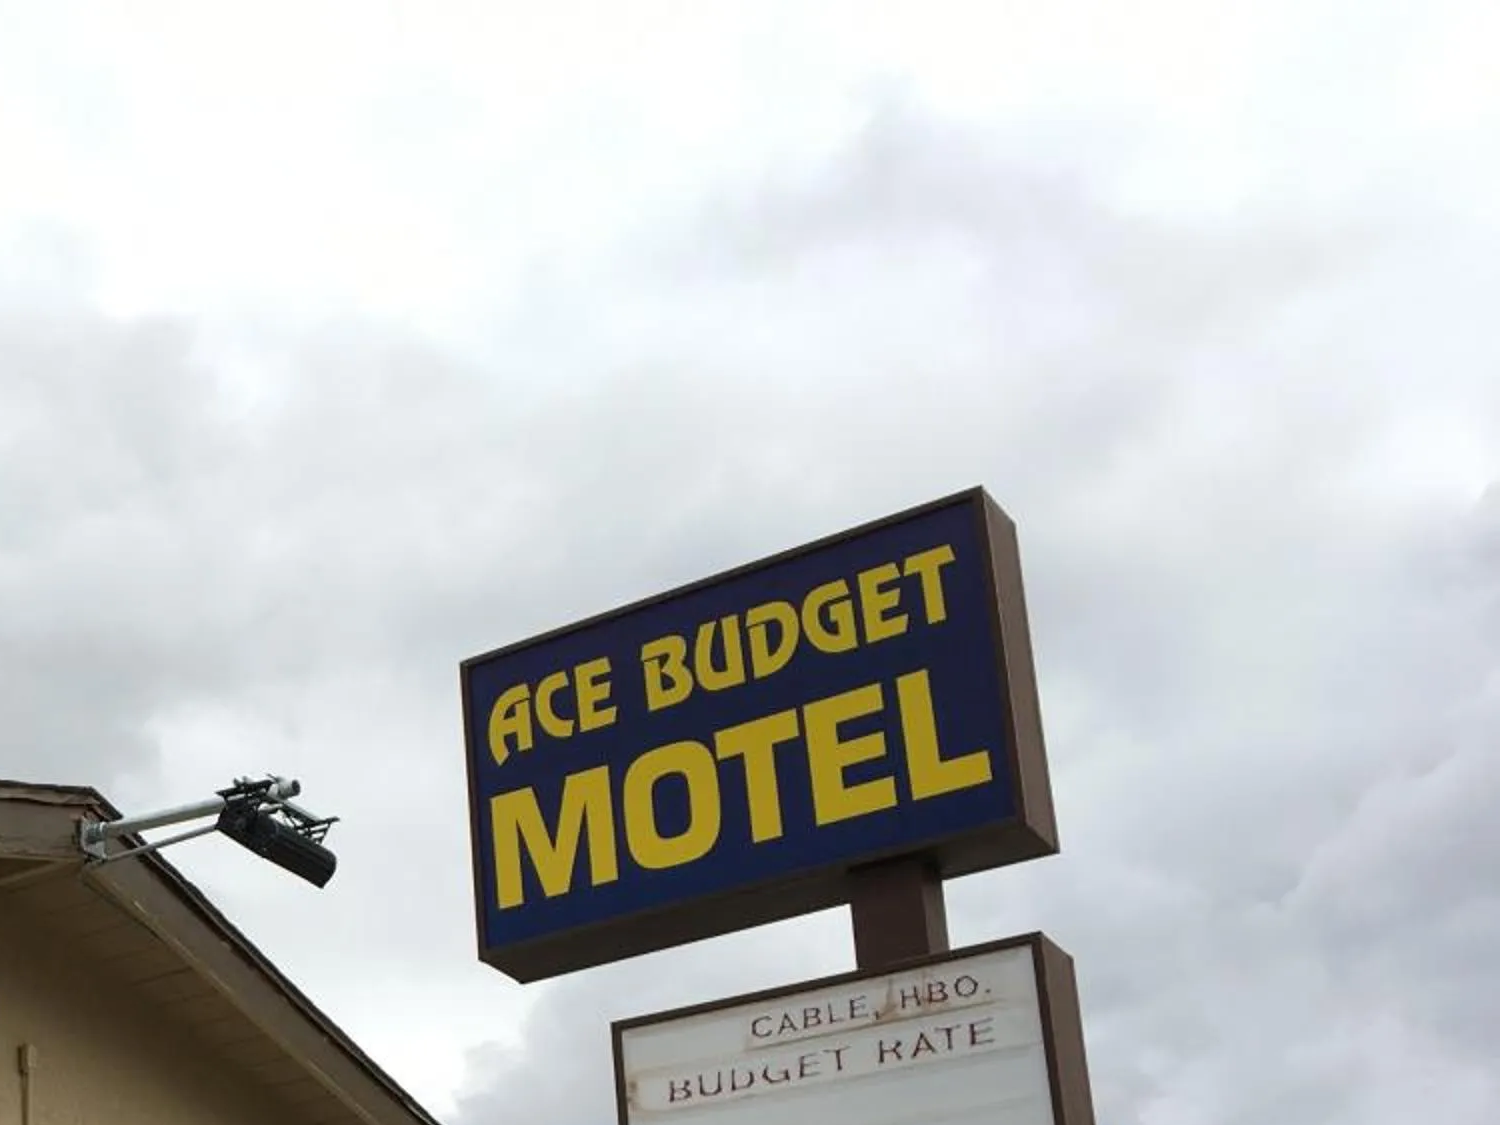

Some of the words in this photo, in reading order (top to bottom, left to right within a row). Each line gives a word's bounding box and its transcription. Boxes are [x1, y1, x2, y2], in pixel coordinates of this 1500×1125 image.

[488, 656, 618, 767] ACE
[640, 543, 956, 712] BUDGET
[490, 668, 993, 910] MOTEL
[668, 1044, 851, 1103] BUDGET
[878, 1017, 996, 1064] RATE
